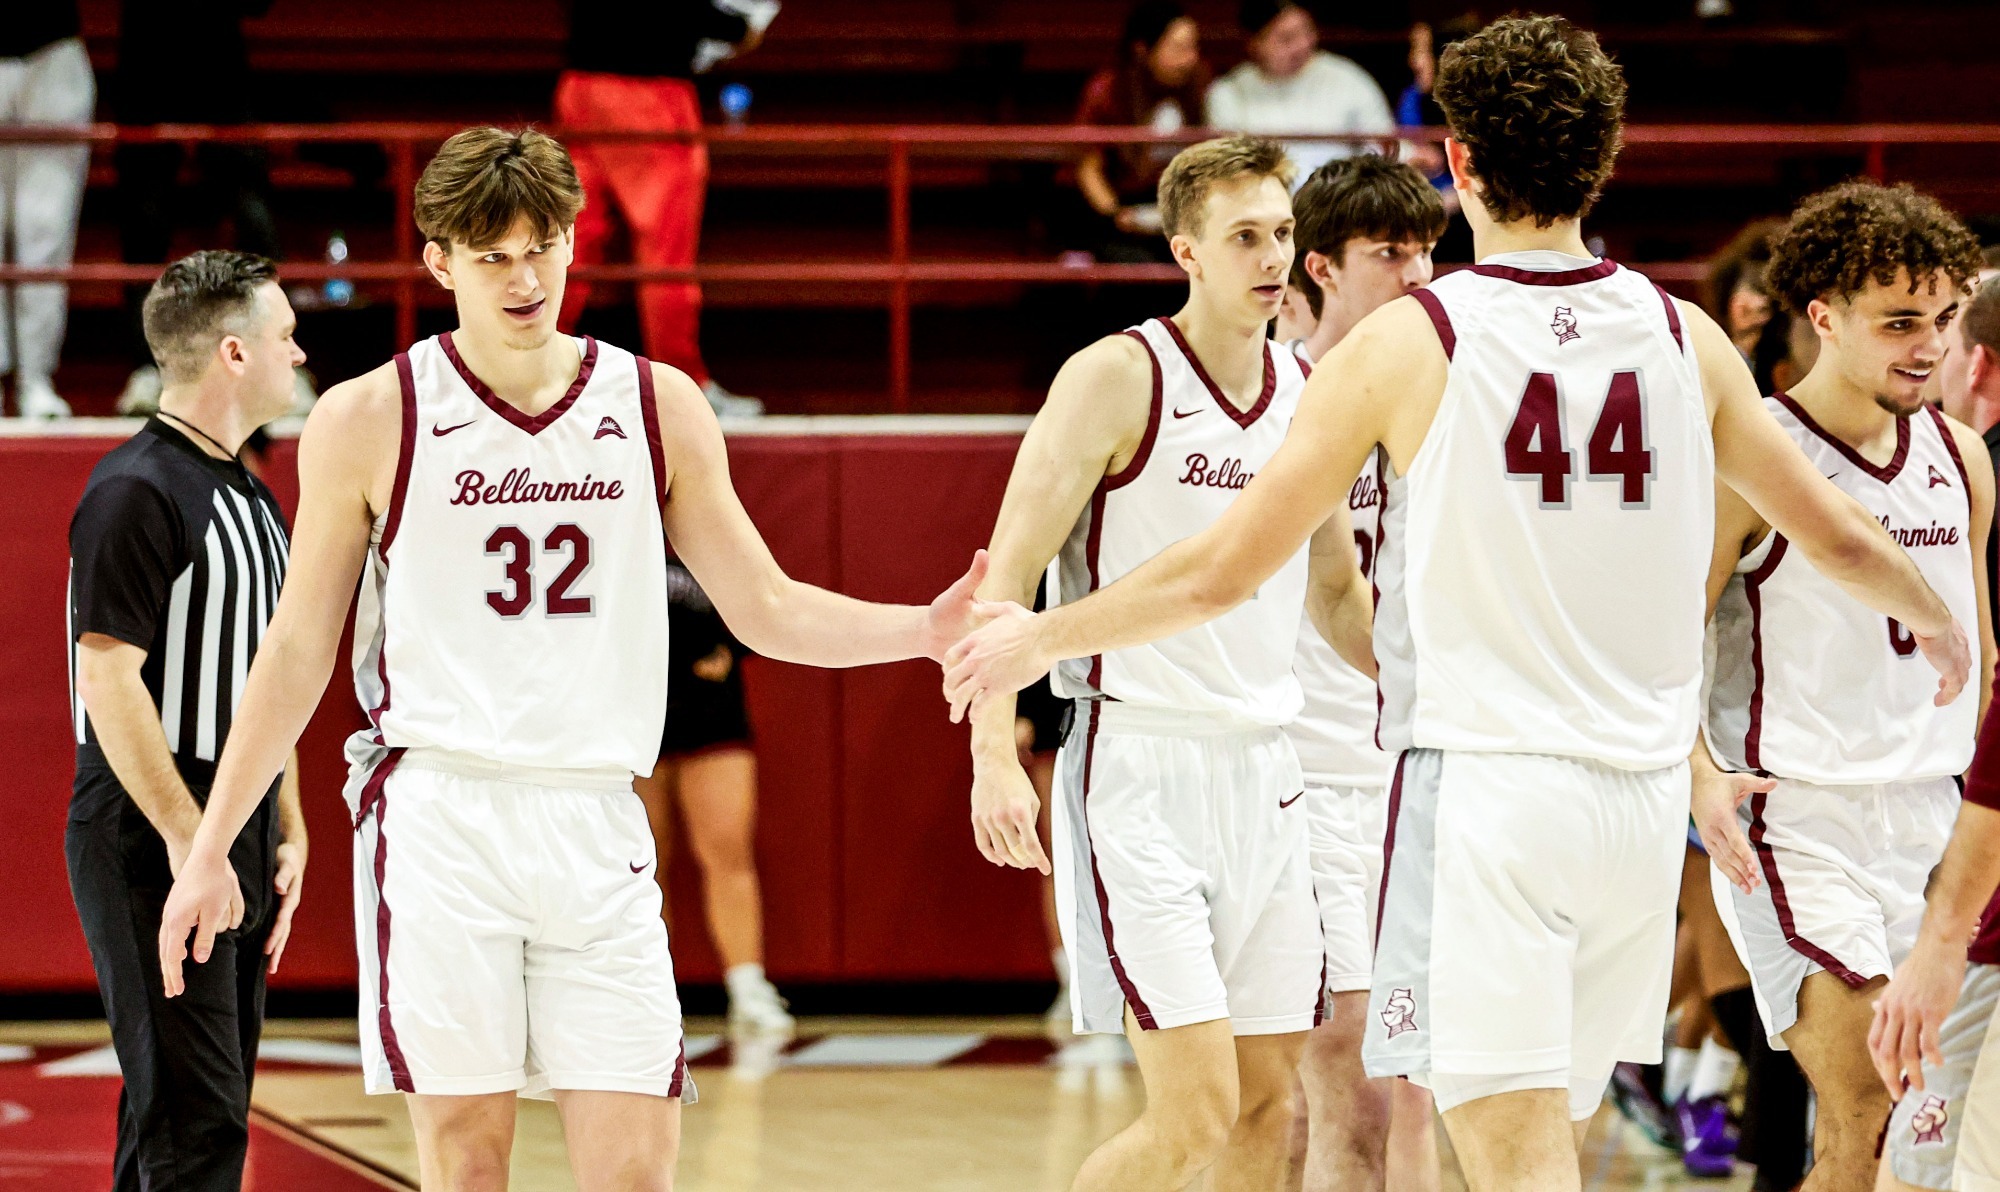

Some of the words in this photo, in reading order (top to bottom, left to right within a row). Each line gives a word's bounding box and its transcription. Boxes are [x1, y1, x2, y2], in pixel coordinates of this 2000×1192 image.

[1501, 367, 1658, 510] 44
[450, 467, 624, 506] Bellarmine
[1875, 514, 1959, 547] rmine
[483, 522, 596, 620] 32
